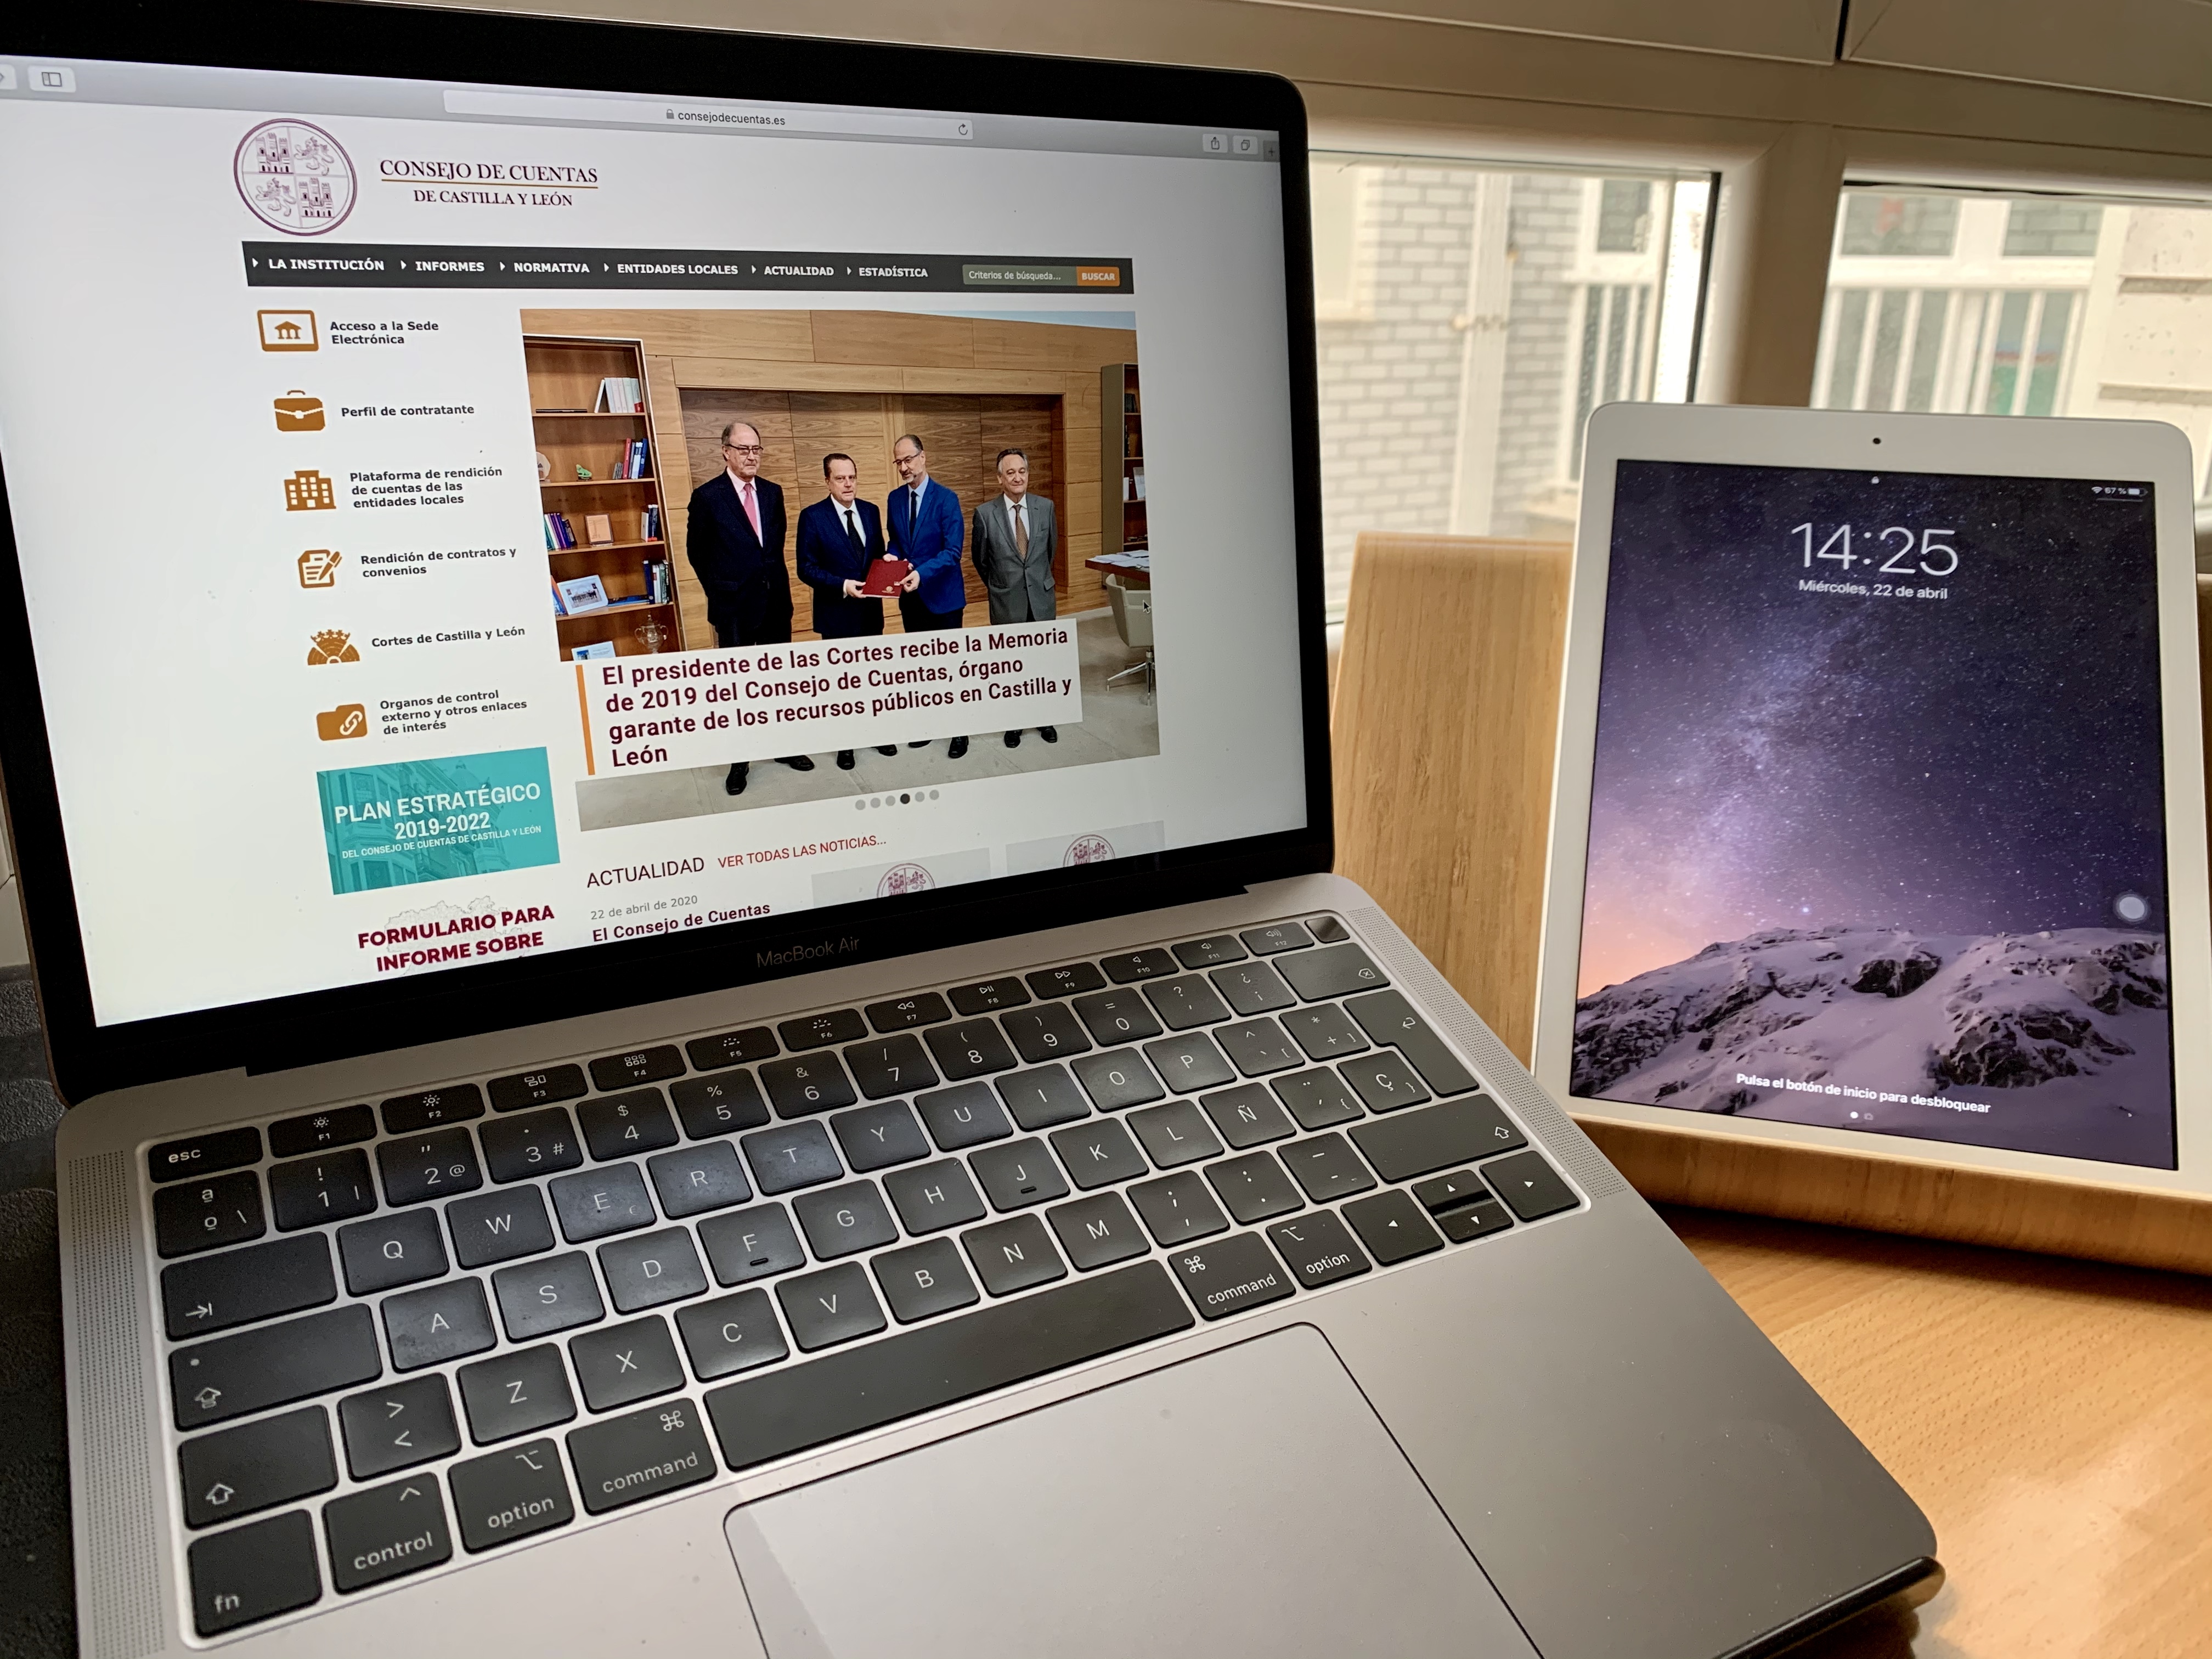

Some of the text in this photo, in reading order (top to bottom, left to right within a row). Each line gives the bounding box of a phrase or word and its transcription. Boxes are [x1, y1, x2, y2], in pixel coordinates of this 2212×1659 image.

[678, 111, 786, 125] consejodecuentas.es
[380, 160, 597, 183] CONSEJO DE CUENTAS
[414, 190, 573, 206] DE CASTILLA Y LEÓN
[269, 257, 385, 270] LA INSTITUCIÓN
[415, 261, 484, 272] INFORMES
[514, 262, 590, 273] NORMATIVA
[617, 263, 738, 274] ENTIDADES LOCALES
[764, 266, 834, 275] ACTUALIDAD
[859, 265, 928, 277] ESTADÍSTICA
[969, 270, 1061, 282] Criterios de búsqueda...
[1082, 272, 1115, 281] BUSCAR
[330, 321, 376, 331] Acceso
[392, 321, 404, 330] la
[407, 321, 439, 331] Sede
[332, 334, 404, 345] Electrónica
[341, 405, 475, 417] Perfil de contratante
[350, 467, 503, 482] Plataforma de rendición
[352, 481, 462, 495] de cuentas de las
[354, 494, 464, 509] entidades locales
[361, 549, 517, 565] Rendición de contratos y
[1791, 522, 1958, 577] 14:25
[363, 565, 427, 578] convenios
[1799, 579, 1948, 599] Miércoles, 22 de abril
[371, 627, 526, 647] Cortes de Castilla y León
[603, 628, 1068, 687] El presidente de las Cortes recibe la Memoria
[606, 659, 1023, 713] de 2019 del Consejo de Cuentas, órgano
[380, 690, 499, 712] Organos de control
[610, 677, 1071, 744] garante de los recursos públicos en Castilla y
[382, 700, 527, 723] externo y otros enlaces
[383, 720, 447, 735] de interés
[612, 745, 668, 768] León
[335, 783, 541, 823] PLAN ESTRATÉGICO
[394, 812, 491, 840] 2019-2022
[342, 849, 359, 859] DEL
[361, 844, 402, 856] CONSEJO
[404, 842, 415, 850] DE
[417, 837, 456, 849] CUENTAS
[458, 834, 470, 843] DE
[472, 830, 510, 842] CASTILLA
[520, 825, 541, 835] LEÓN
[586, 835, 887, 888] ACTUALIDAD VER TODAS LAS NOTICIAS...
[591, 895, 697, 920] 22 de abril de 2020
[358, 905, 555, 949] FORMULARIO PARA
[592, 904, 771, 942] El Consejo de Cuentas
[377, 932, 544, 972] INFORME SOBRE
[757, 936, 860, 967] MacBook Air
[968, 1050, 983, 1064] 8
[804, 1086, 820, 1101] 6
[1736, 1074, 1991, 1114] Pulsa el botón de inicio para desbloquear
[716, 1105, 731, 1120] 5
[624, 1125, 640, 1141] 4
[168, 1148, 201, 1163] esc
[783, 1148, 797, 1164] T
[1089, 1144, 1109, 1161] K
[690, 1170, 708, 1187] R
[485, 1215, 511, 1235] W
[837, 1210, 855, 1227] G
[1086, 1220, 1109, 1239] M
[383, 1240, 404, 1260] Q
[1003, 1243, 1024, 1263] N
[1306, 1252, 1350, 1276] option
[915, 1269, 934, 1288] B
[1207, 1273, 1277, 1305] command
[506, 1381, 527, 1404] Z
[602, 1452, 698, 1493] command
[487, 1497, 554, 1529] option
[354, 1532, 433, 1570] control
[214, 1594, 240, 1614] fn
